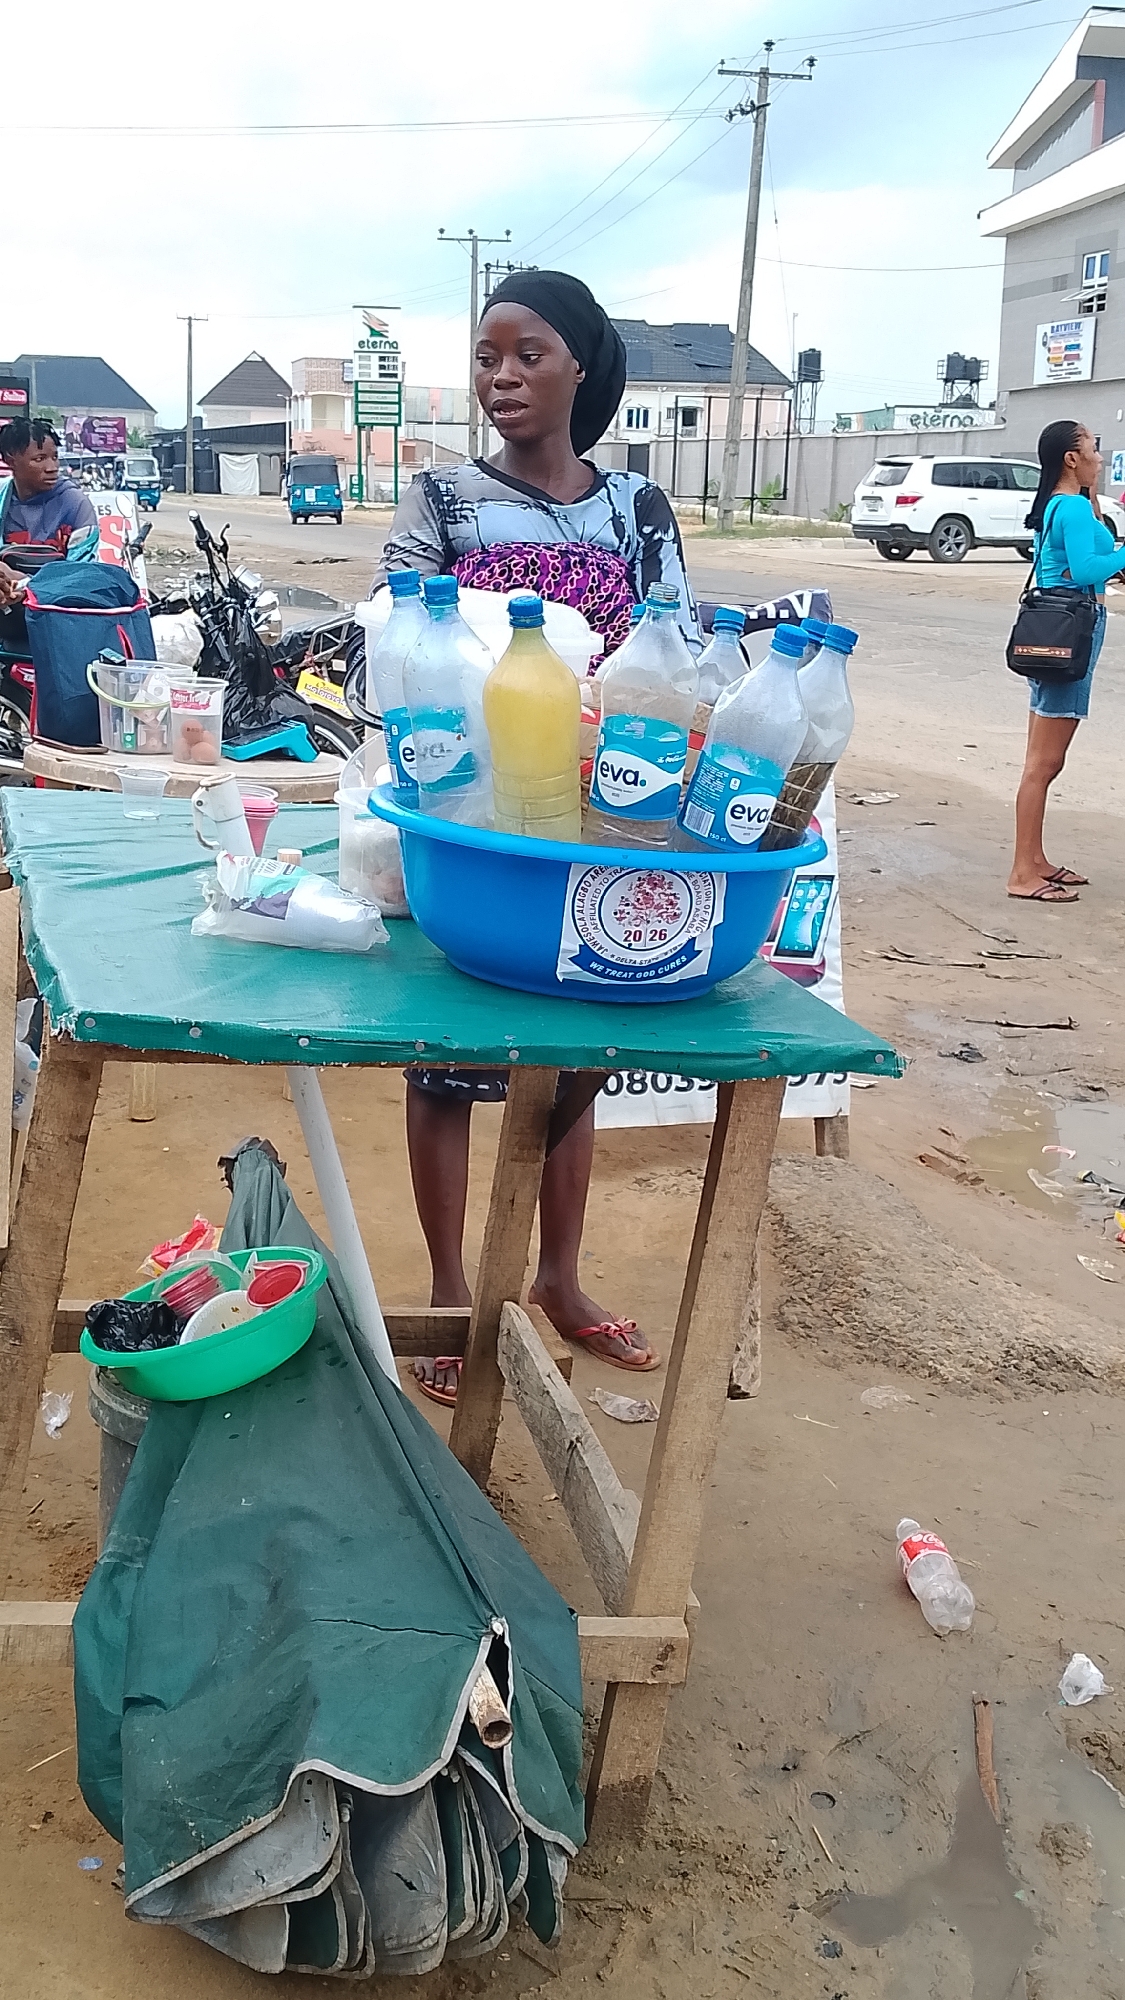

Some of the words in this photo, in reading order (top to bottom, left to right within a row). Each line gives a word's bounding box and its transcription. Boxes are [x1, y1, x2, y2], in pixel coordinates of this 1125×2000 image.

[358, 338, 399, 350] eterna
[910, 412, 975, 429] eterna
[599, 877, 610, 887] TO
[699, 872, 712, 902] CIATION
[576, 880, 592, 915] ALAGBO
[692, 880, 702, 906] BOARD
[702, 904, 711, 917] OF
[577, 916, 609, 955] JAWESOLA
[589, 961, 604, 972] WE
[604, 967, 634, 979] TREAT
[635, 970, 656, 979] GOD
[657, 955, 688, 974] CURES
[615, 956, 637, 965] DELTA
